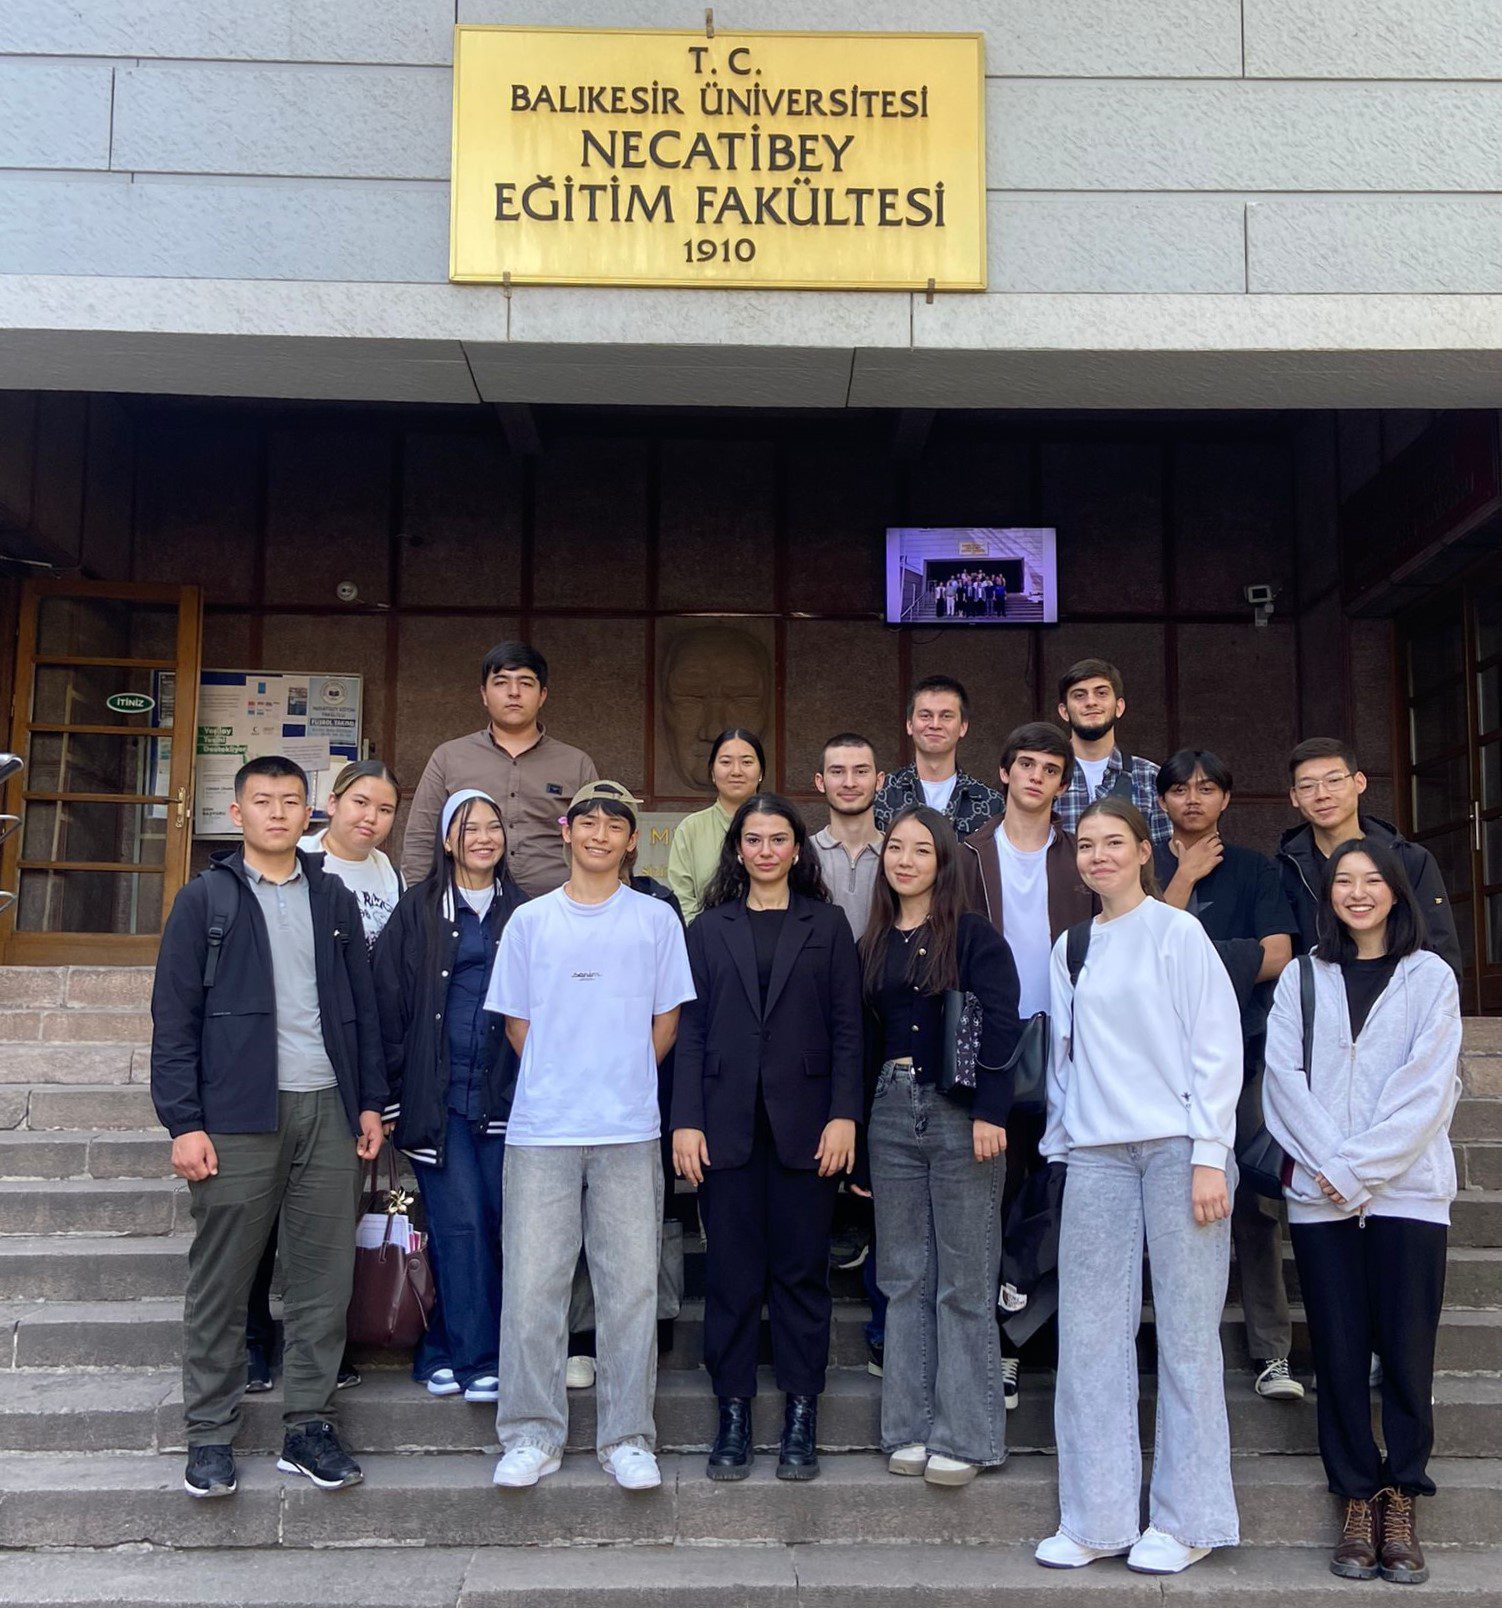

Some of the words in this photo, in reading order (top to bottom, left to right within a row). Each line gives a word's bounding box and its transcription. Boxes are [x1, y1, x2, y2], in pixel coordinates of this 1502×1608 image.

[687, 46, 718, 75] T.
[728, 47, 763, 76] C.
[510, 80, 685, 116] BALIKESİR
[699, 81, 929, 119] ÜNİVERSİTESİ
[580, 123, 855, 173] NECATİBEY
[494, 174, 675, 224] EĞİTİM
[695, 176, 946, 228] FAKÜLTESİ
[683, 238, 756, 263] 1910
